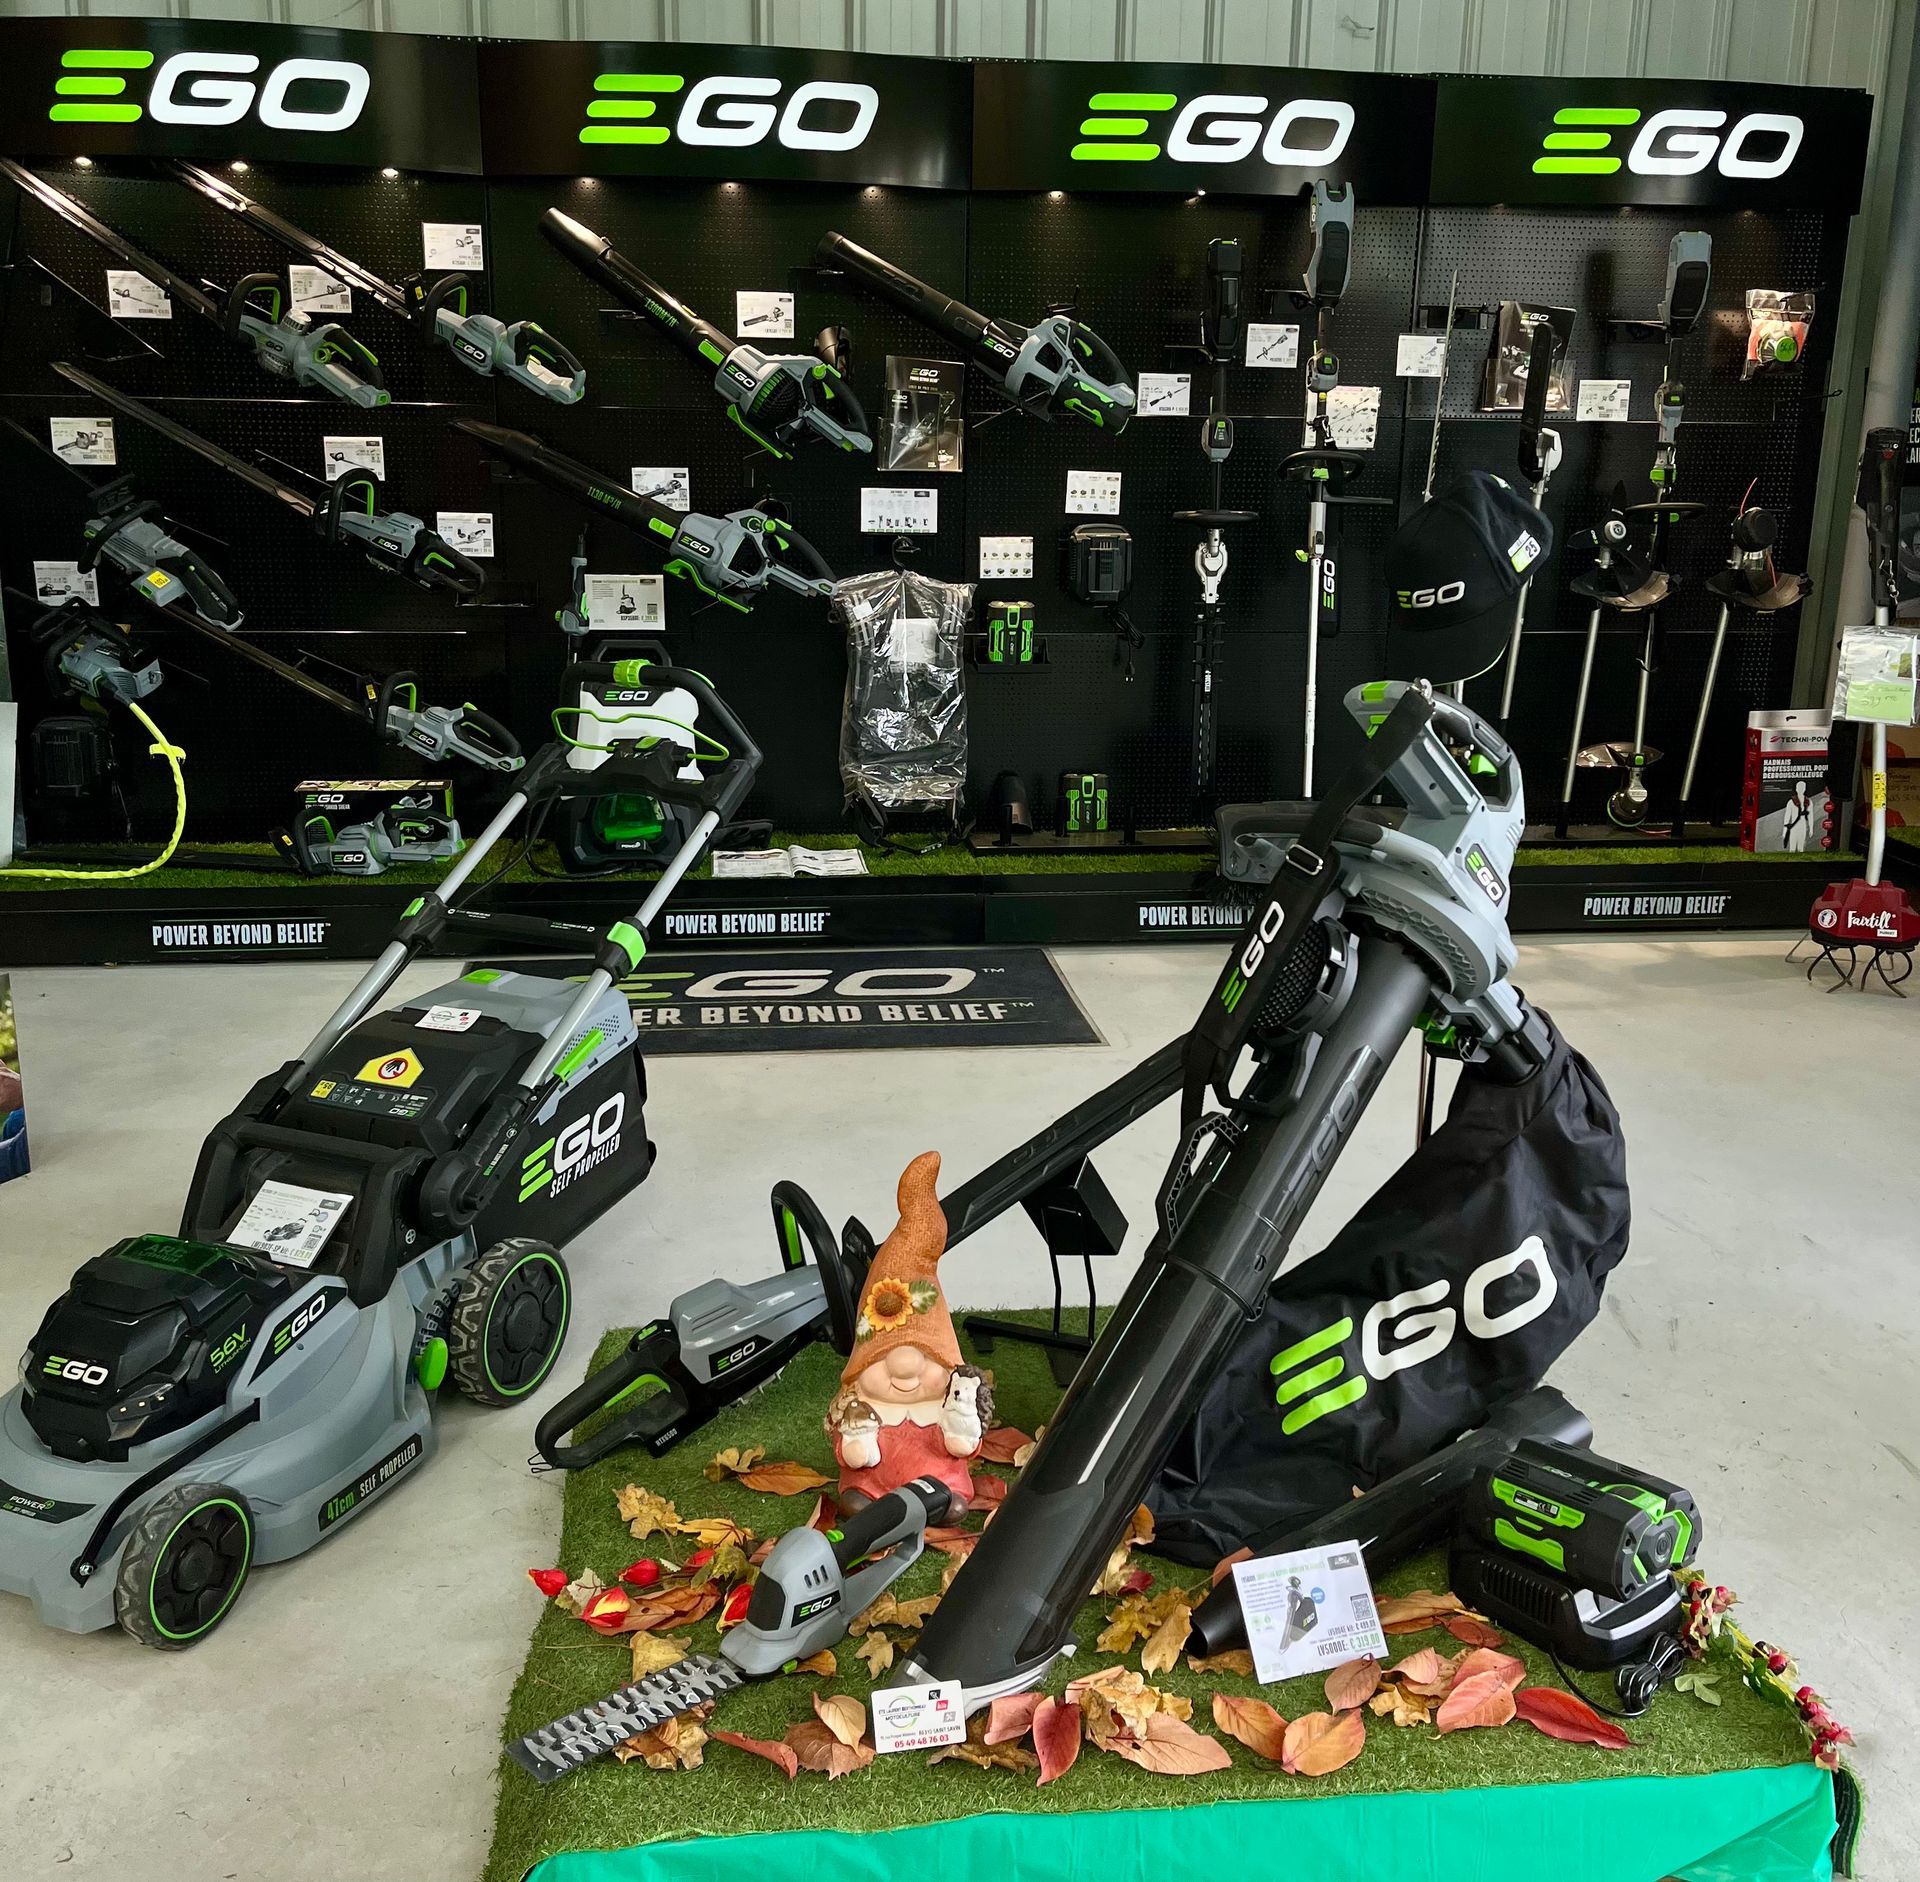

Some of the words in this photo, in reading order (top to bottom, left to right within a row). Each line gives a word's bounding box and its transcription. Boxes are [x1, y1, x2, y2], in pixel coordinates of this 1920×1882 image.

[49, 49, 370, 131] EGO
[579, 73, 880, 151] EGO
[1071, 92, 1356, 168] EGO
[1533, 106, 1806, 180] EGO
[1521, 311, 1549, 321] EGO
[455, 338, 486, 361] EGO
[983, 337, 1016, 358] EGO
[726, 364, 755, 390] EGO
[910, 367, 939, 377] EGO
[378, 538, 398, 551] EGO
[682, 535, 711, 554] EGO
[1524, 540, 1540, 558] 25
[1322, 558, 1336, 611] EGO
[1396, 580, 1466, 610] EGO
[604, 690, 650, 702] EGO
[412, 730, 436, 747] EGO
[305, 794, 344, 803] EGO
[334, 853, 364, 863] EGO
[1466, 850, 1503, 901] EGO
[1139, 907, 1187, 926] POWER
[1191, 905, 1243, 925] BEYOND
[1584, 897, 1630, 916] POWER
[1633, 896, 1682, 915] BEYOND
[152, 925, 208, 946] POWER
[213, 924, 272, 945] BEYOND
[665, 914, 719, 934] POWER
[723, 913, 776, 932] BEYOND
[1220, 900, 1285, 1014] EGO
[701, 1004, 862, 1025] BEYOND
[518, 1091, 626, 1204] EGO
[1288, 1080, 1359, 1211] EGO
[549, 1172, 574, 1199] SELF
[573, 1132, 622, 1182] PROPELLED
[274, 1291, 328, 1356] EGO
[1270, 1235, 1559, 1435] EGO
[210, 1323, 249, 1367] 56V
[717, 1342, 756, 1368] EGO
[43, 1355, 109, 1386] EGO
[326, 1491, 355, 1523] 47cm
[359, 1473, 377, 1498] SELF
[378, 1443, 417, 1480] PROPELLED
[800, 1596, 833, 1617] EGO
[894, 1741, 905, 1749] 05
[906, 1739, 916, 1748] 49
[917, 1738, 928, 1746] 48
[939, 1734, 949, 1742] 03
